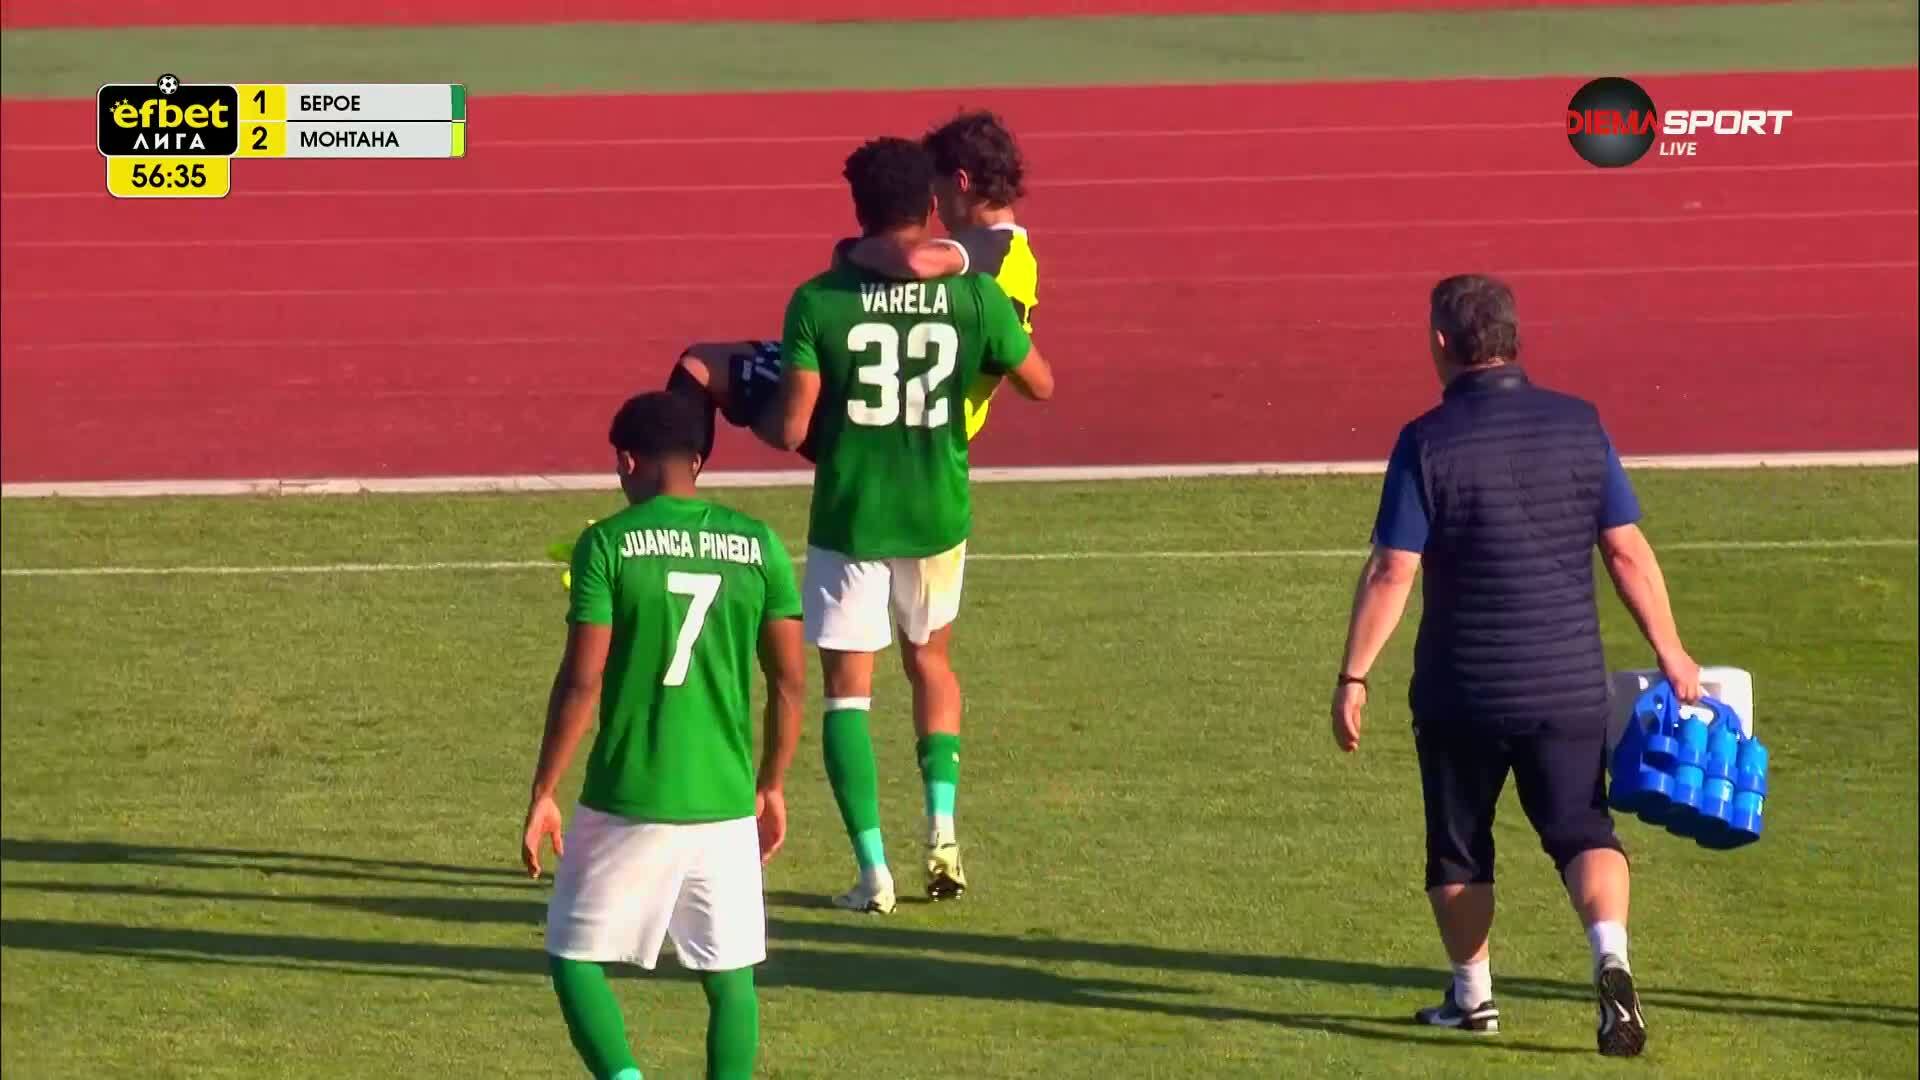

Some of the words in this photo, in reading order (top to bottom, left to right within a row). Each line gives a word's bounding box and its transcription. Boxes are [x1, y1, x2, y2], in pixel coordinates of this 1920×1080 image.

[859, 282, 949, 315] VARELA
[846, 321, 959, 429] 32
[620, 529, 695, 558] JUANCA
[698, 531, 763, 566] PINEDA
[662, 571, 723, 687] 7
